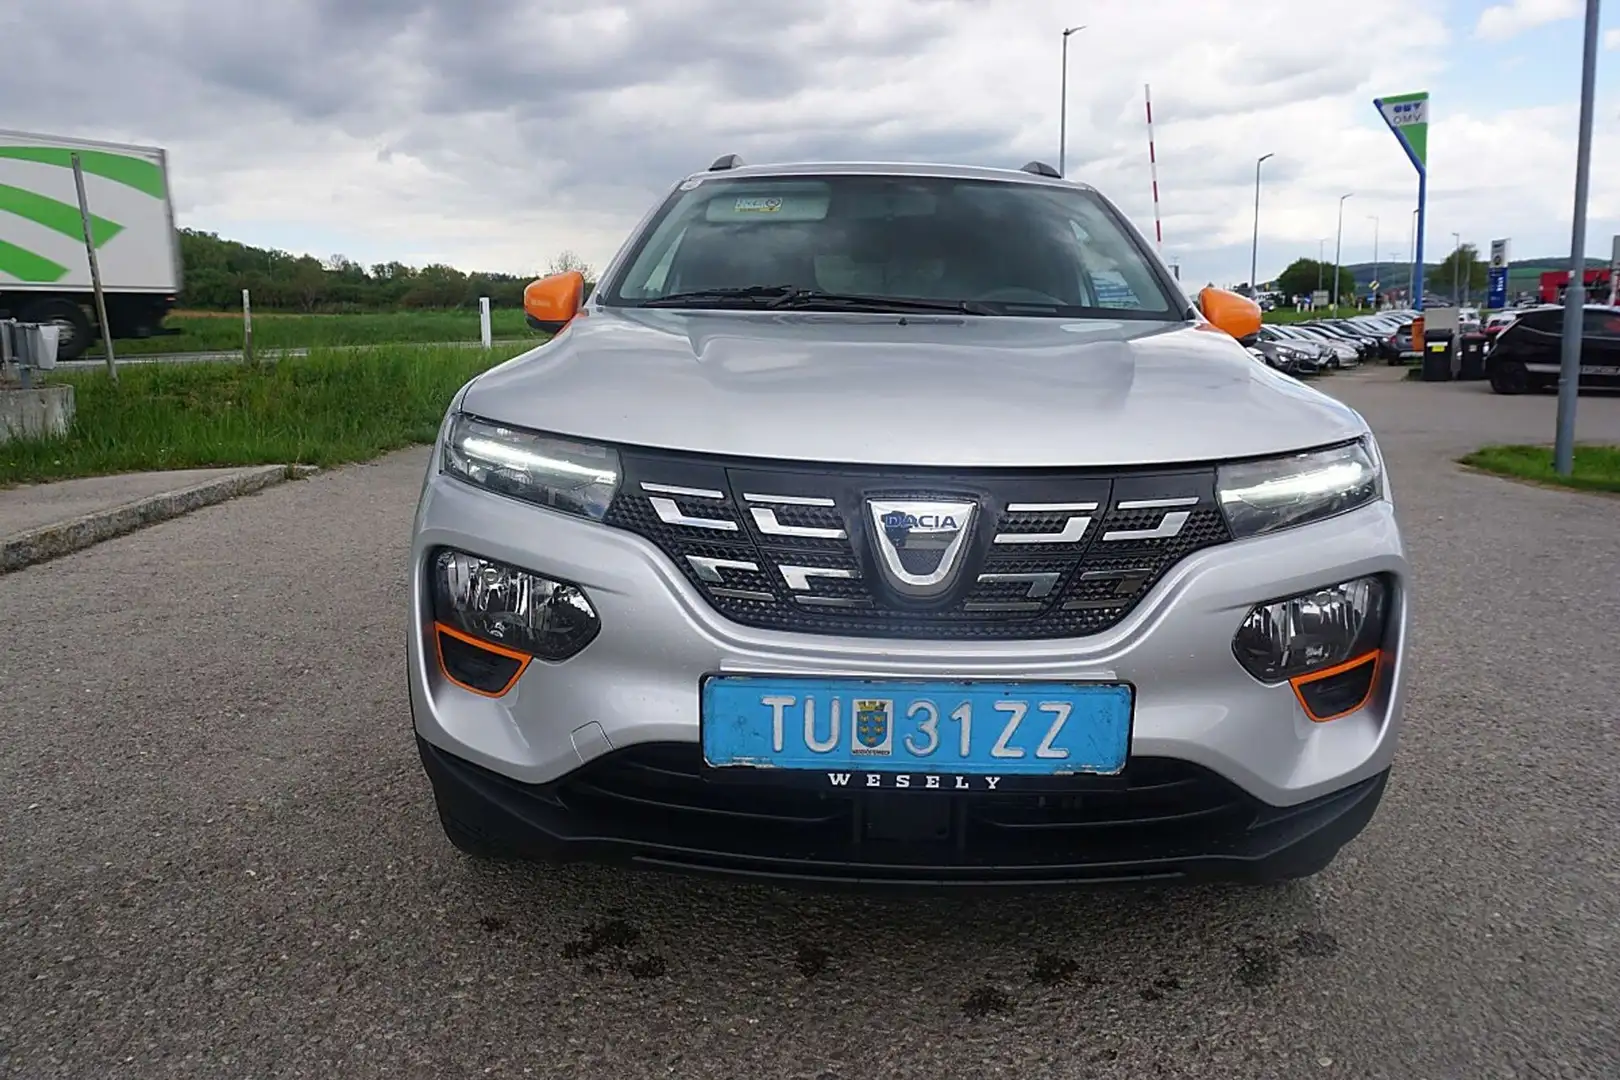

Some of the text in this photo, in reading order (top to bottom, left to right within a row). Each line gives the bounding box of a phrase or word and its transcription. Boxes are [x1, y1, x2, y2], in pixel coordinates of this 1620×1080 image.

[1393, 114, 1421, 125] OMV
[885, 514, 957, 528] DACIA
[761, 696, 841, 754] TU
[828, 773, 1001, 789] WESELY
